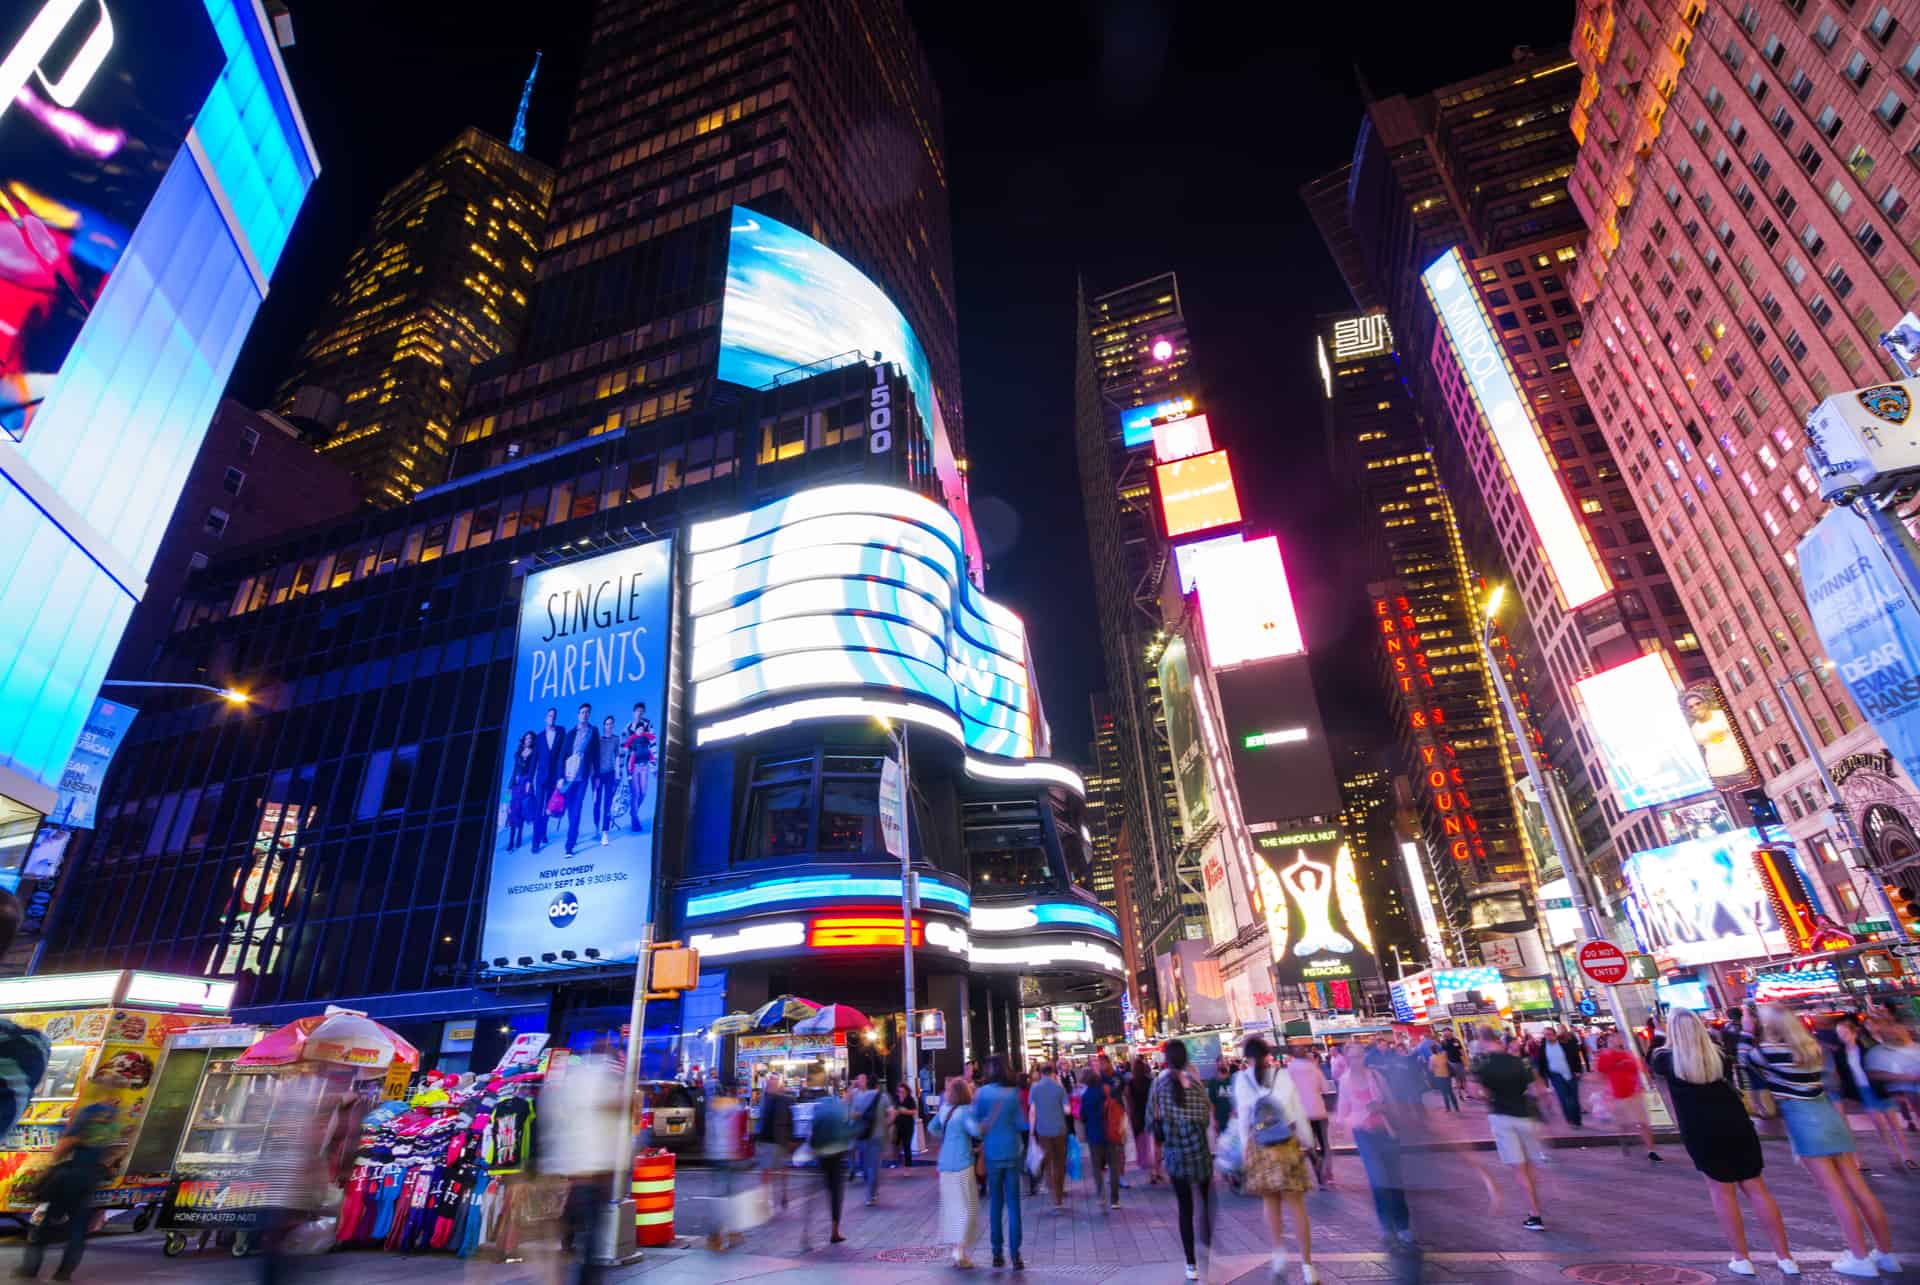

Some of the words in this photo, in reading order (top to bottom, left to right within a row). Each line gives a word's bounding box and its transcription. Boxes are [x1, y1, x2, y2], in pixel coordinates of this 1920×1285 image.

[869, 364, 892, 454] 1500
[1808, 555, 1872, 604] WINNER
[542, 572, 643, 642] SINGLE
[529, 627, 647, 702] PARENTS
[1842, 641, 1904, 682] DEAR
[1850, 660, 1908, 700] EVAN
[1863, 674, 1920, 718] HANS
[1375, 600, 1411, 692] ERNST
[1411, 710, 1427, 729] &
[1422, 746, 1470, 862] YOUNG
[507, 882, 553, 896] WEDNESDAY
[554, 879, 574, 889] SEPT
[575, 877, 585, 888] 26
[539, 868, 559, 880] NEW
[560, 863, 595, 876] COMEDY
[549, 899, 579, 918] abc
[1584, 948, 1597, 958] DO
[1599, 947, 1615, 957] NOT
[1593, 966, 1620, 977] ENTER
[388, 1082, 402, 1097] 10
